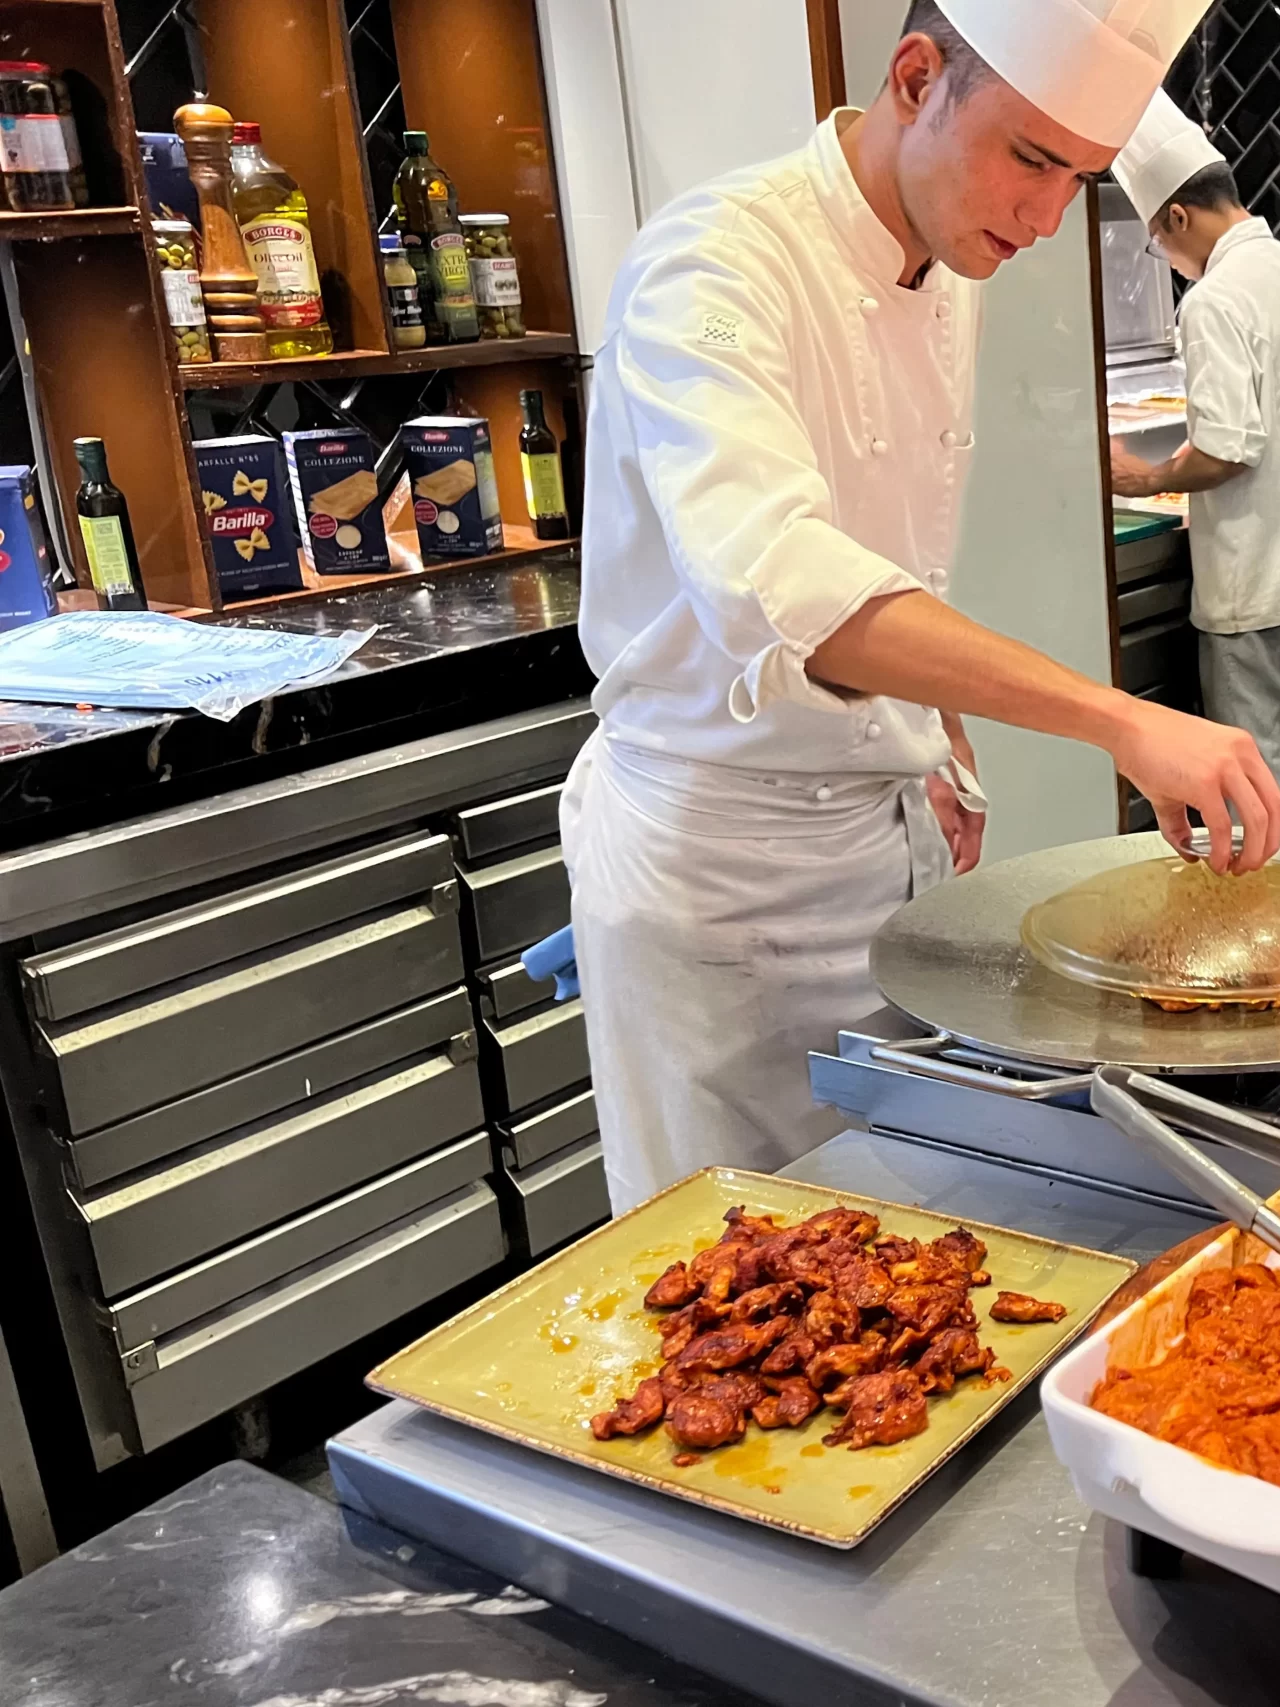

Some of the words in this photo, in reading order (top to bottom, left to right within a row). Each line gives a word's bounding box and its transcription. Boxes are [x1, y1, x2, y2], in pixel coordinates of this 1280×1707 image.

[251, 226, 297, 240] BORGES
[436, 265, 469, 278] VIRGI
[319, 444, 346, 454] Barilla
[410, 444, 465, 454] COLLEZIONE
[198, 457, 235, 468] ARFALLE
[304, 455, 365, 467] COLLEZIONE
[212, 512, 267, 532] Barilla
